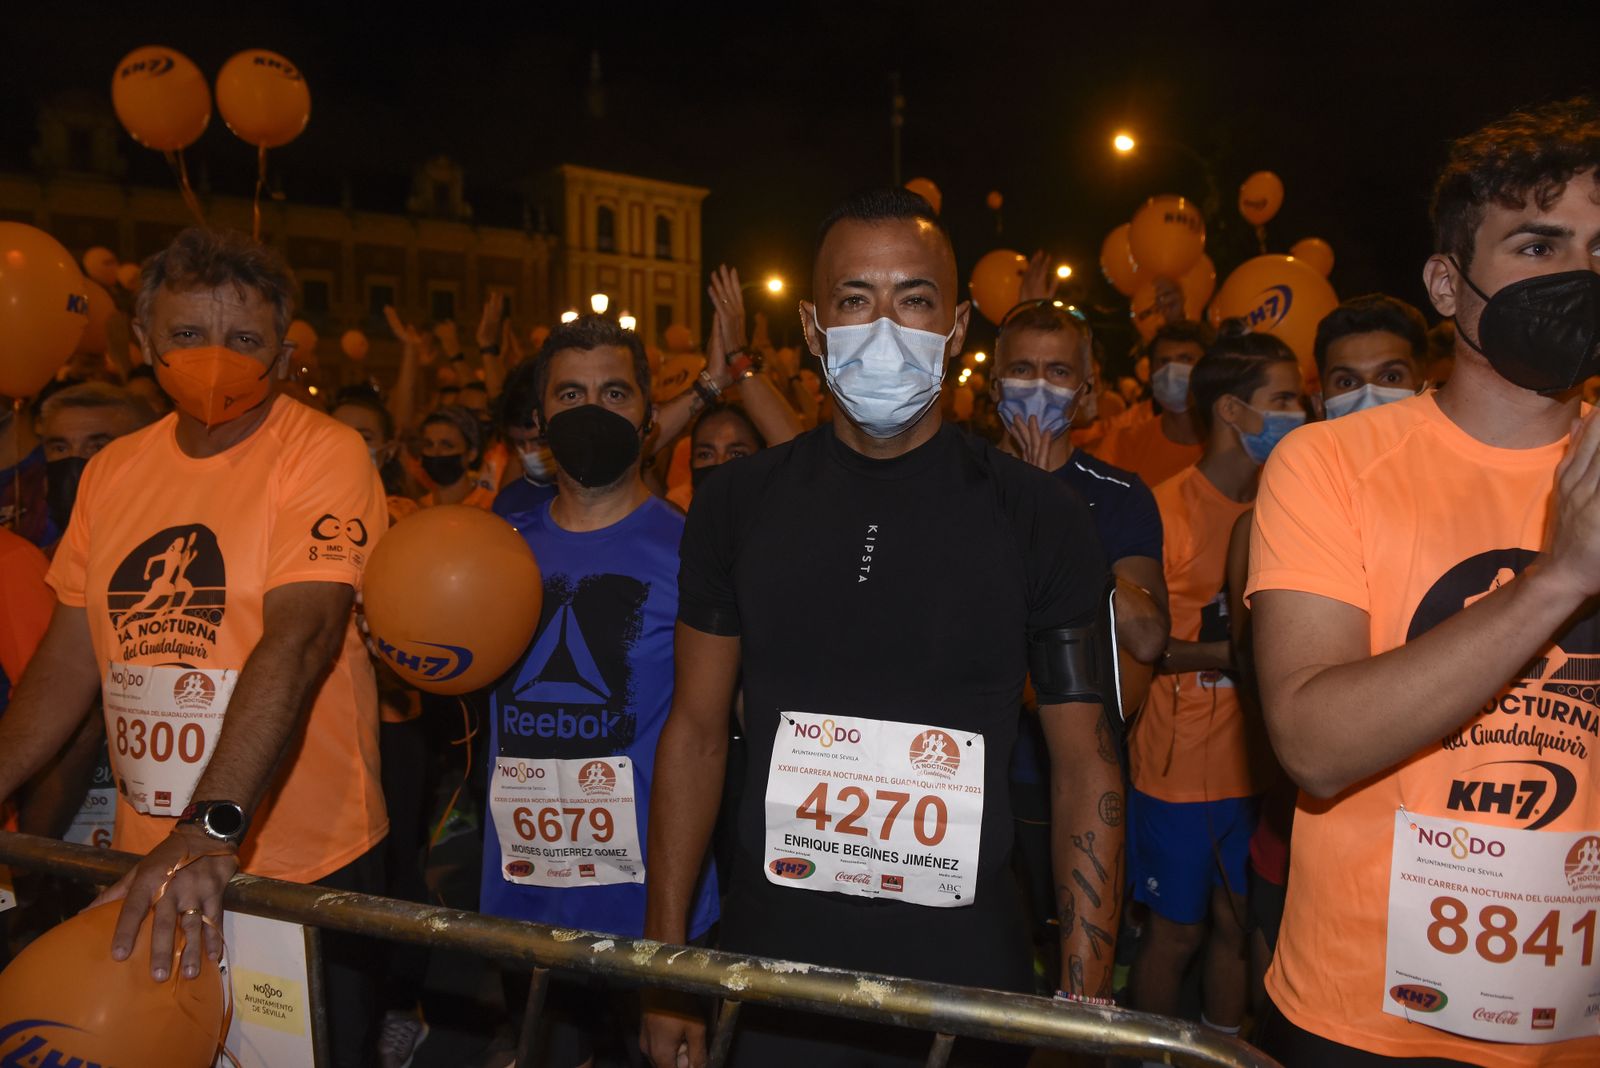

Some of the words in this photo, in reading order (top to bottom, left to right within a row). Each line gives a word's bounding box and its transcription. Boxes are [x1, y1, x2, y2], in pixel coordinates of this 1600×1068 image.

[326, 544, 343, 552] IMD
[858, 524, 879, 583] KIPSTA
[118, 629, 133, 645] LA
[138, 619, 216, 645] NOCTURNA
[123, 643, 138, 661] del
[139, 638, 208, 660] Guadalquivir
[503, 704, 622, 739] Reebok
[1476, 694, 1600, 737] OCTURNA
[116, 716, 206, 764] 8300
[1470, 722, 1588, 760] Guadalquivir
[777, 764, 799, 773] XXXIII
[799, 766, 832, 778] CARRERA
[832, 770, 874, 782] NOCTURNA
[875, 775, 889, 784] DEL
[890, 777, 946, 790] GUADALQUIVIR
[948, 783, 963, 792] KH7
[965, 785, 982, 795] 2021
[921, 763, 956, 776] NOCTURNA
[513, 807, 614, 843] 6679
[795, 782, 948, 847] 4270
[511, 844, 542, 857] MOISES
[543, 847, 593, 858] GUTIERREZ
[594, 848, 628, 858] GOMEZ
[784, 833, 840, 855] ENRIQUE
[843, 843, 899, 865] BEGINES
[902, 852, 960, 871] JIMÉNEZ
[938, 882, 962, 893] ABC
[1400, 872, 1426, 885] XXXIII
[1427, 878, 1469, 894] CARRERA
[1471, 887, 1524, 902] NOCTURNA
[1525, 893, 1541, 903] DEL
[1426, 895, 1597, 967] 8841
